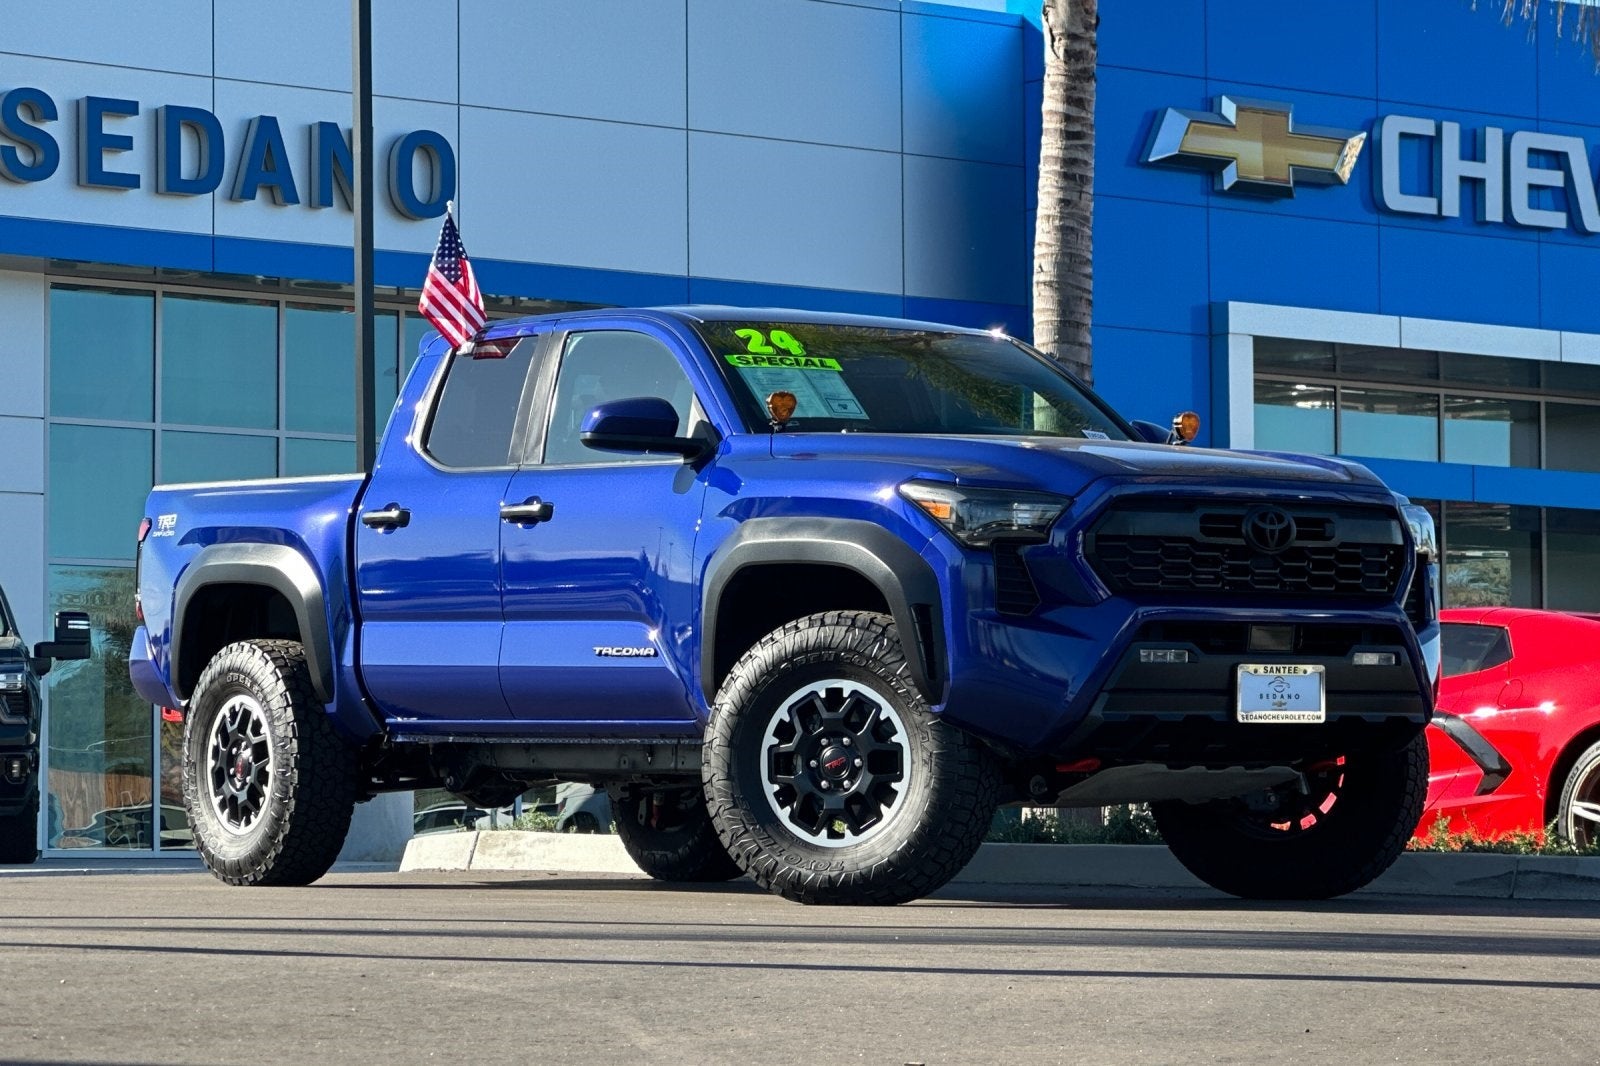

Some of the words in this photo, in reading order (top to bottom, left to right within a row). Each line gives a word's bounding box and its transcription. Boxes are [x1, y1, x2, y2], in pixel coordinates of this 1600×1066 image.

[0, 86, 456, 220] SEDANO
[734, 328, 806, 356] 24
[735, 355, 835, 369] SPECIAL
[593, 646, 658, 657] TACOMA
[1263, 665, 1299, 675] SANTEE
[1241, 713, 1322, 721] SEDANOCHEVROLET.COM
